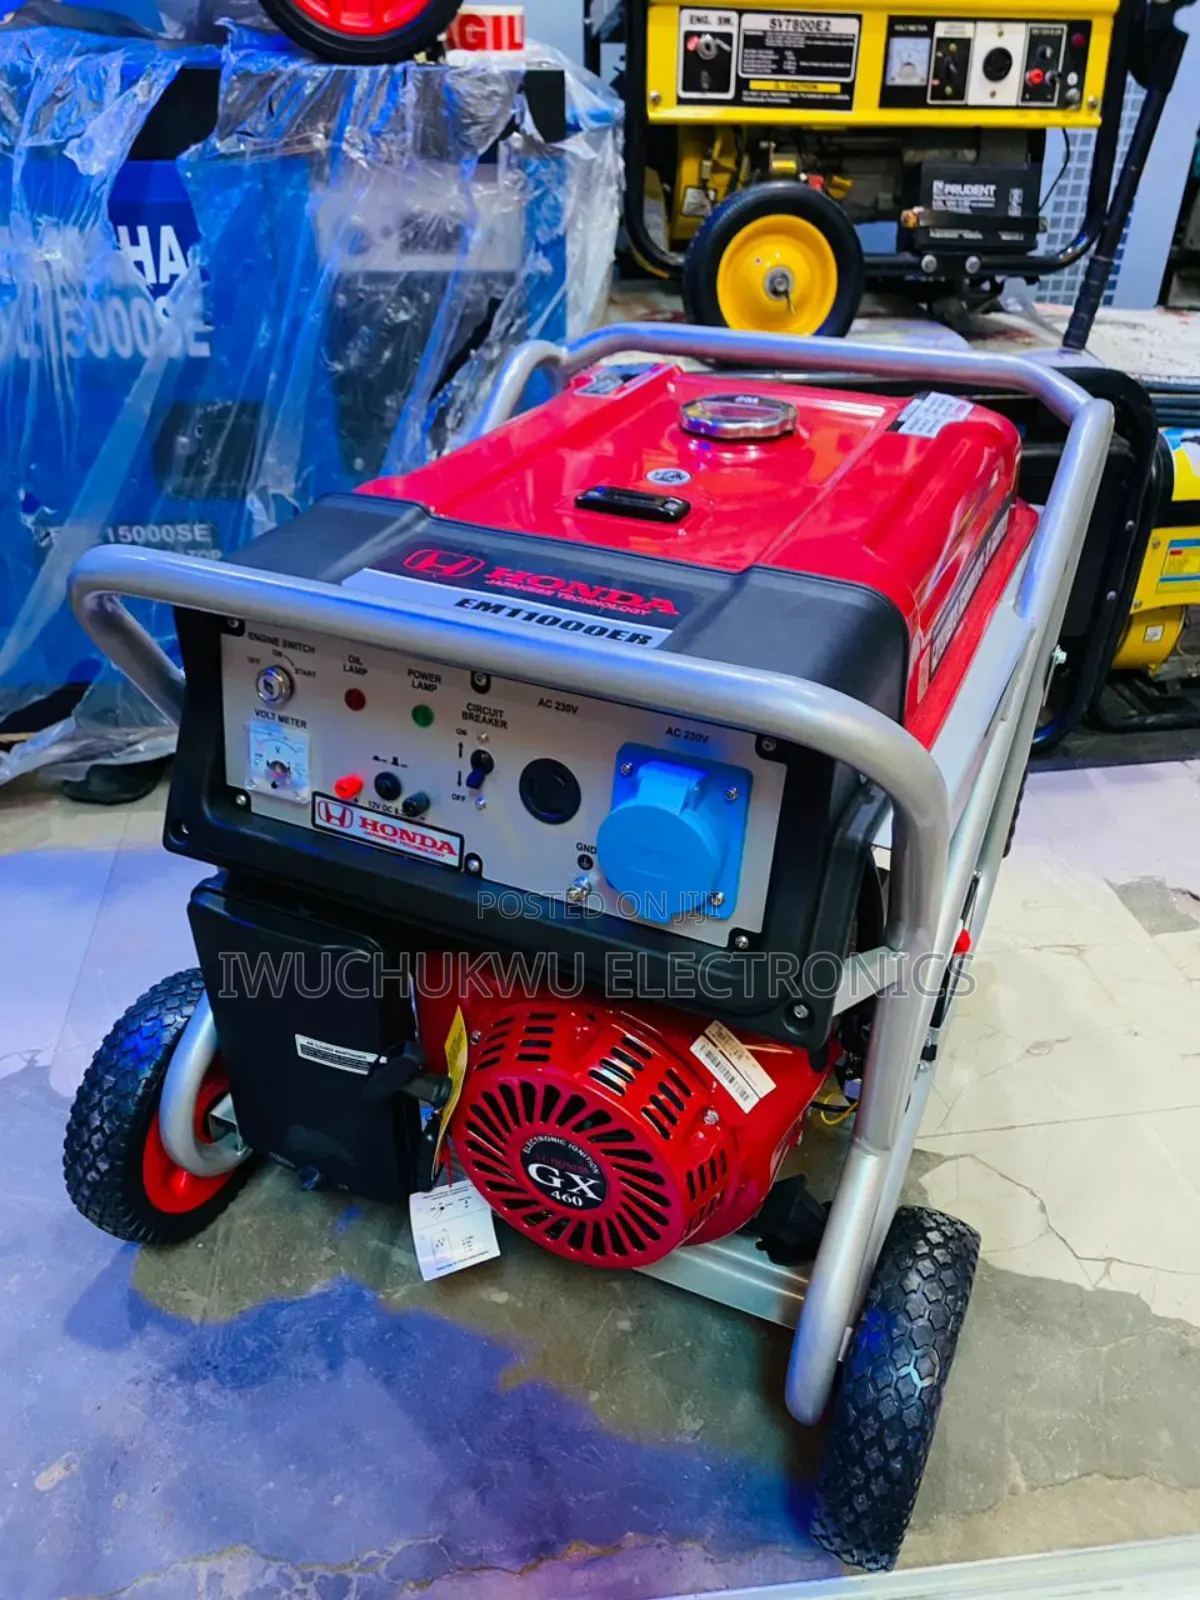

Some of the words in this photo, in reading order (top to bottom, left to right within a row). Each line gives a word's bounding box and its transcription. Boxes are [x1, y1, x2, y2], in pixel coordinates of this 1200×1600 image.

[446, 13, 524, 51] GIL
[944, 184, 997, 197] PRUDENT
[485, 566, 679, 616] HONDA
[453, 597, 653, 645] EM11000ER
[248, 631, 281, 647] ENGINE
[282, 641, 316, 655] SWITCH
[348, 654, 363, 666] OIL
[343, 663, 368, 676] LAMP
[407, 668, 442, 684] POWER
[412, 679, 438, 693] LAMP
[466, 702, 505, 719] CIRCUIT
[538, 697, 553, 710] AC
[554, 700, 579, 715] 230V
[254, 708, 277, 722] VOLT
[278, 714, 307, 729] METER
[462, 710, 508, 730] BREAKER
[456, 727, 467, 736] ON
[665, 726, 682, 738] AC
[683, 730, 709, 744] 230V
[451, 793, 466, 802] OFF
[382, 803, 393, 814] DC
[359, 816, 457, 856] HONDA
[576, 842, 597, 855] GND
[523, 1135, 566, 1154] ELECTRONIC
[568, 1143, 600, 1175] IGNITION
[528, 1163, 602, 1201] GX
[551, 1190, 583, 1207] 460
